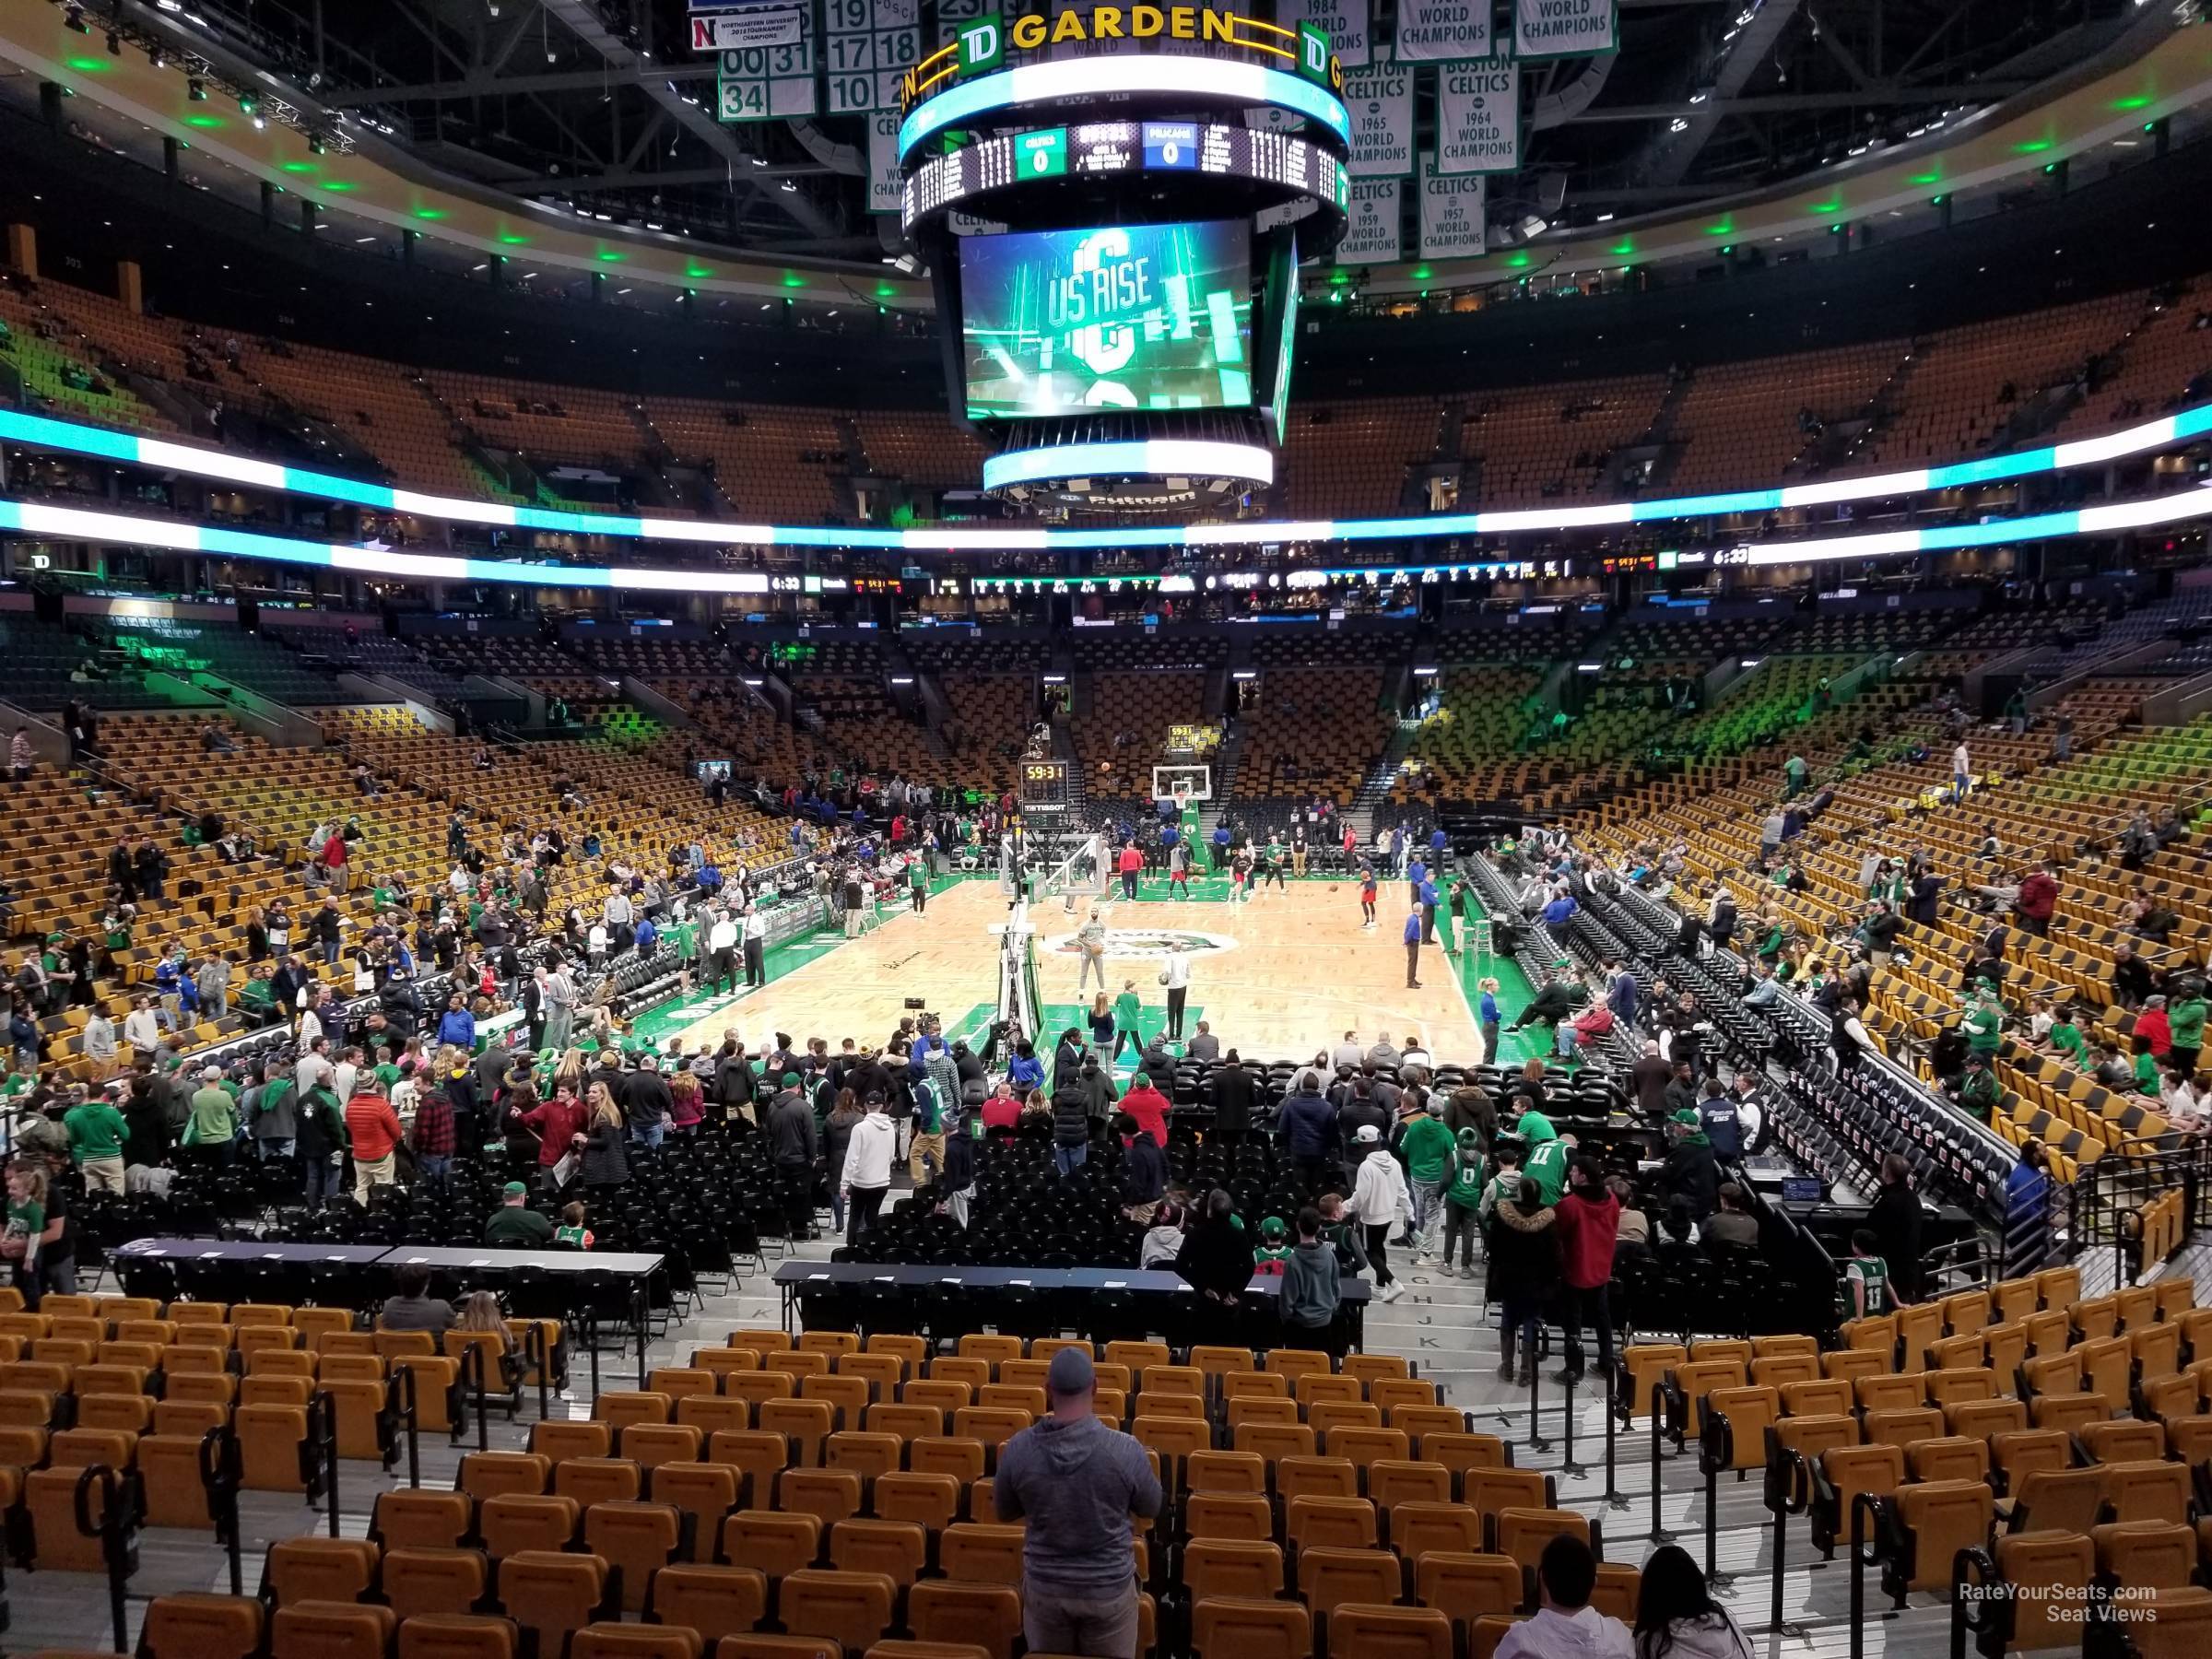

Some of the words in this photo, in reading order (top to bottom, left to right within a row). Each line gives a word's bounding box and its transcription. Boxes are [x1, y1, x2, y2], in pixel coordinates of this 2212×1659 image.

[1418, 6, 1469, 25] WORLD
[1538, 0, 1590, 18] WORLD
[721, 20, 765, 29] NORTHEASTERN
[765, 17, 798, 25] UNIVERSITY
[1013, 6, 1234, 48] GARDEN
[1523, 16, 1606, 38] CHAMPIONS
[742, 33, 778, 41] CHAMPIONS
[1402, 24, 1485, 43] CHAMPIONS
[831, 38, 867, 68] 17
[880, 32, 915, 65] 18
[961, 25, 997, 64] TD
[1302, 31, 1326, 73] TD
[774, 44, 808, 73] 31
[833, 77, 869, 108] 10
[1346, 79, 1405, 100] CELTICS
[1448, 74, 1510, 94] CELTICS
[724, 85, 764, 114] 34
[1361, 117, 1386, 131] 1965
[1465, 112, 1491, 125] 1964
[1354, 132, 1394, 147] WORLD
[1458, 126, 1500, 142] WORLD
[1162, 141, 1179, 165] 0
[1444, 141, 1512, 159] CHAMPIONS
[1032, 149, 1049, 173] 0
[1350, 183, 1394, 200] ELTICS
[1429, 177, 1478, 194] CELTICS
[1358, 215, 1379, 226] 1959
[1443, 208, 1465, 219] 1957
[1351, 227, 1386, 240] WORLD
[1435, 221, 1470, 234] WORLD
[1340, 239, 1396, 253] CHAMPIONS
[1424, 232, 1481, 247] CHAMPIONS
[1048, 273, 1086, 329] US
[1092, 256, 1152, 318] RISE
[1088, 491, 1195, 505] Putnam
[1028, 766, 1063, 779] 59:31
[1531, 1147, 1552, 1165] 11
[1462, 1167, 1475, 1184] 0
[1413, 1295, 1432, 1304] H
[1867, 1287, 1881, 1310] 11
[1417, 1316, 1432, 1325] J
[1419, 1336, 1441, 1348] K
